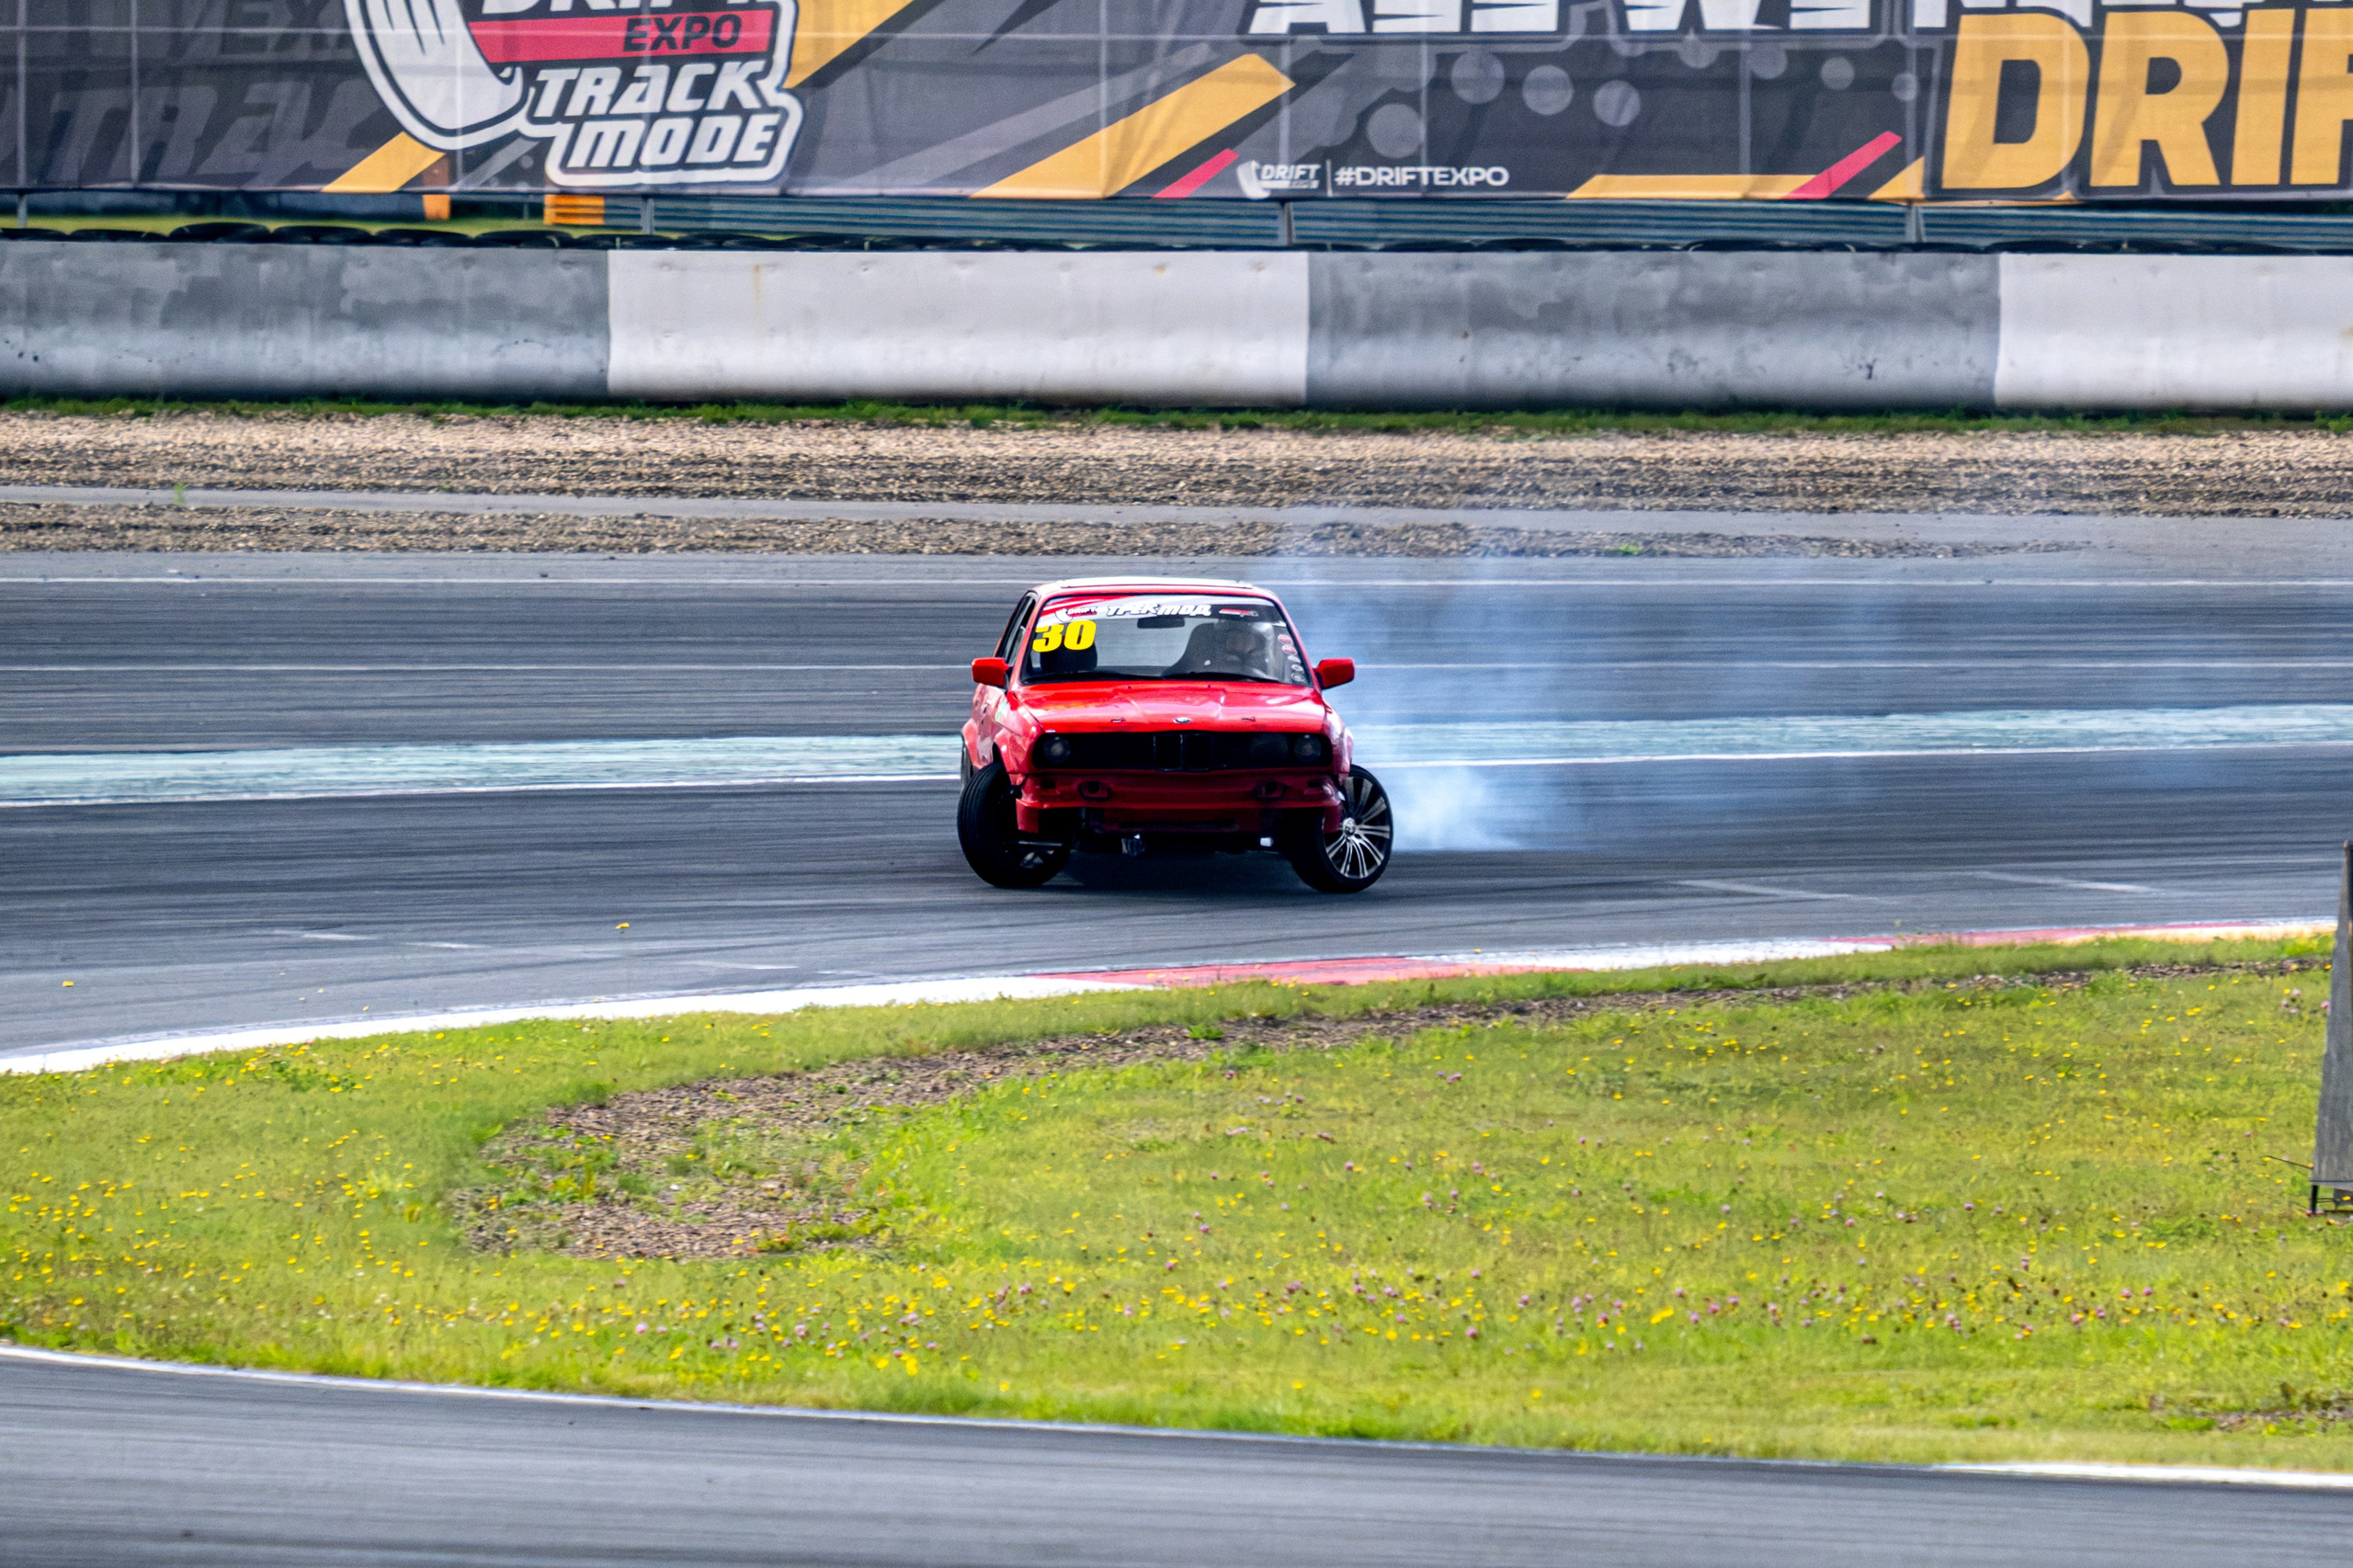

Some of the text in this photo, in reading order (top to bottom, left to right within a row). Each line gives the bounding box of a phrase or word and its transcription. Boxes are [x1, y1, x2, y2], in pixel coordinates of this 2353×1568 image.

[623, 14, 743, 52] EXPO
[532, 60, 770, 118] TRACK
[566, 113, 782, 168] MODE
[1260, 164, 1321, 180] DRIFT
[1334, 165, 1510, 187] #DRIFTEXPO
[1031, 619, 1097, 653] 30
